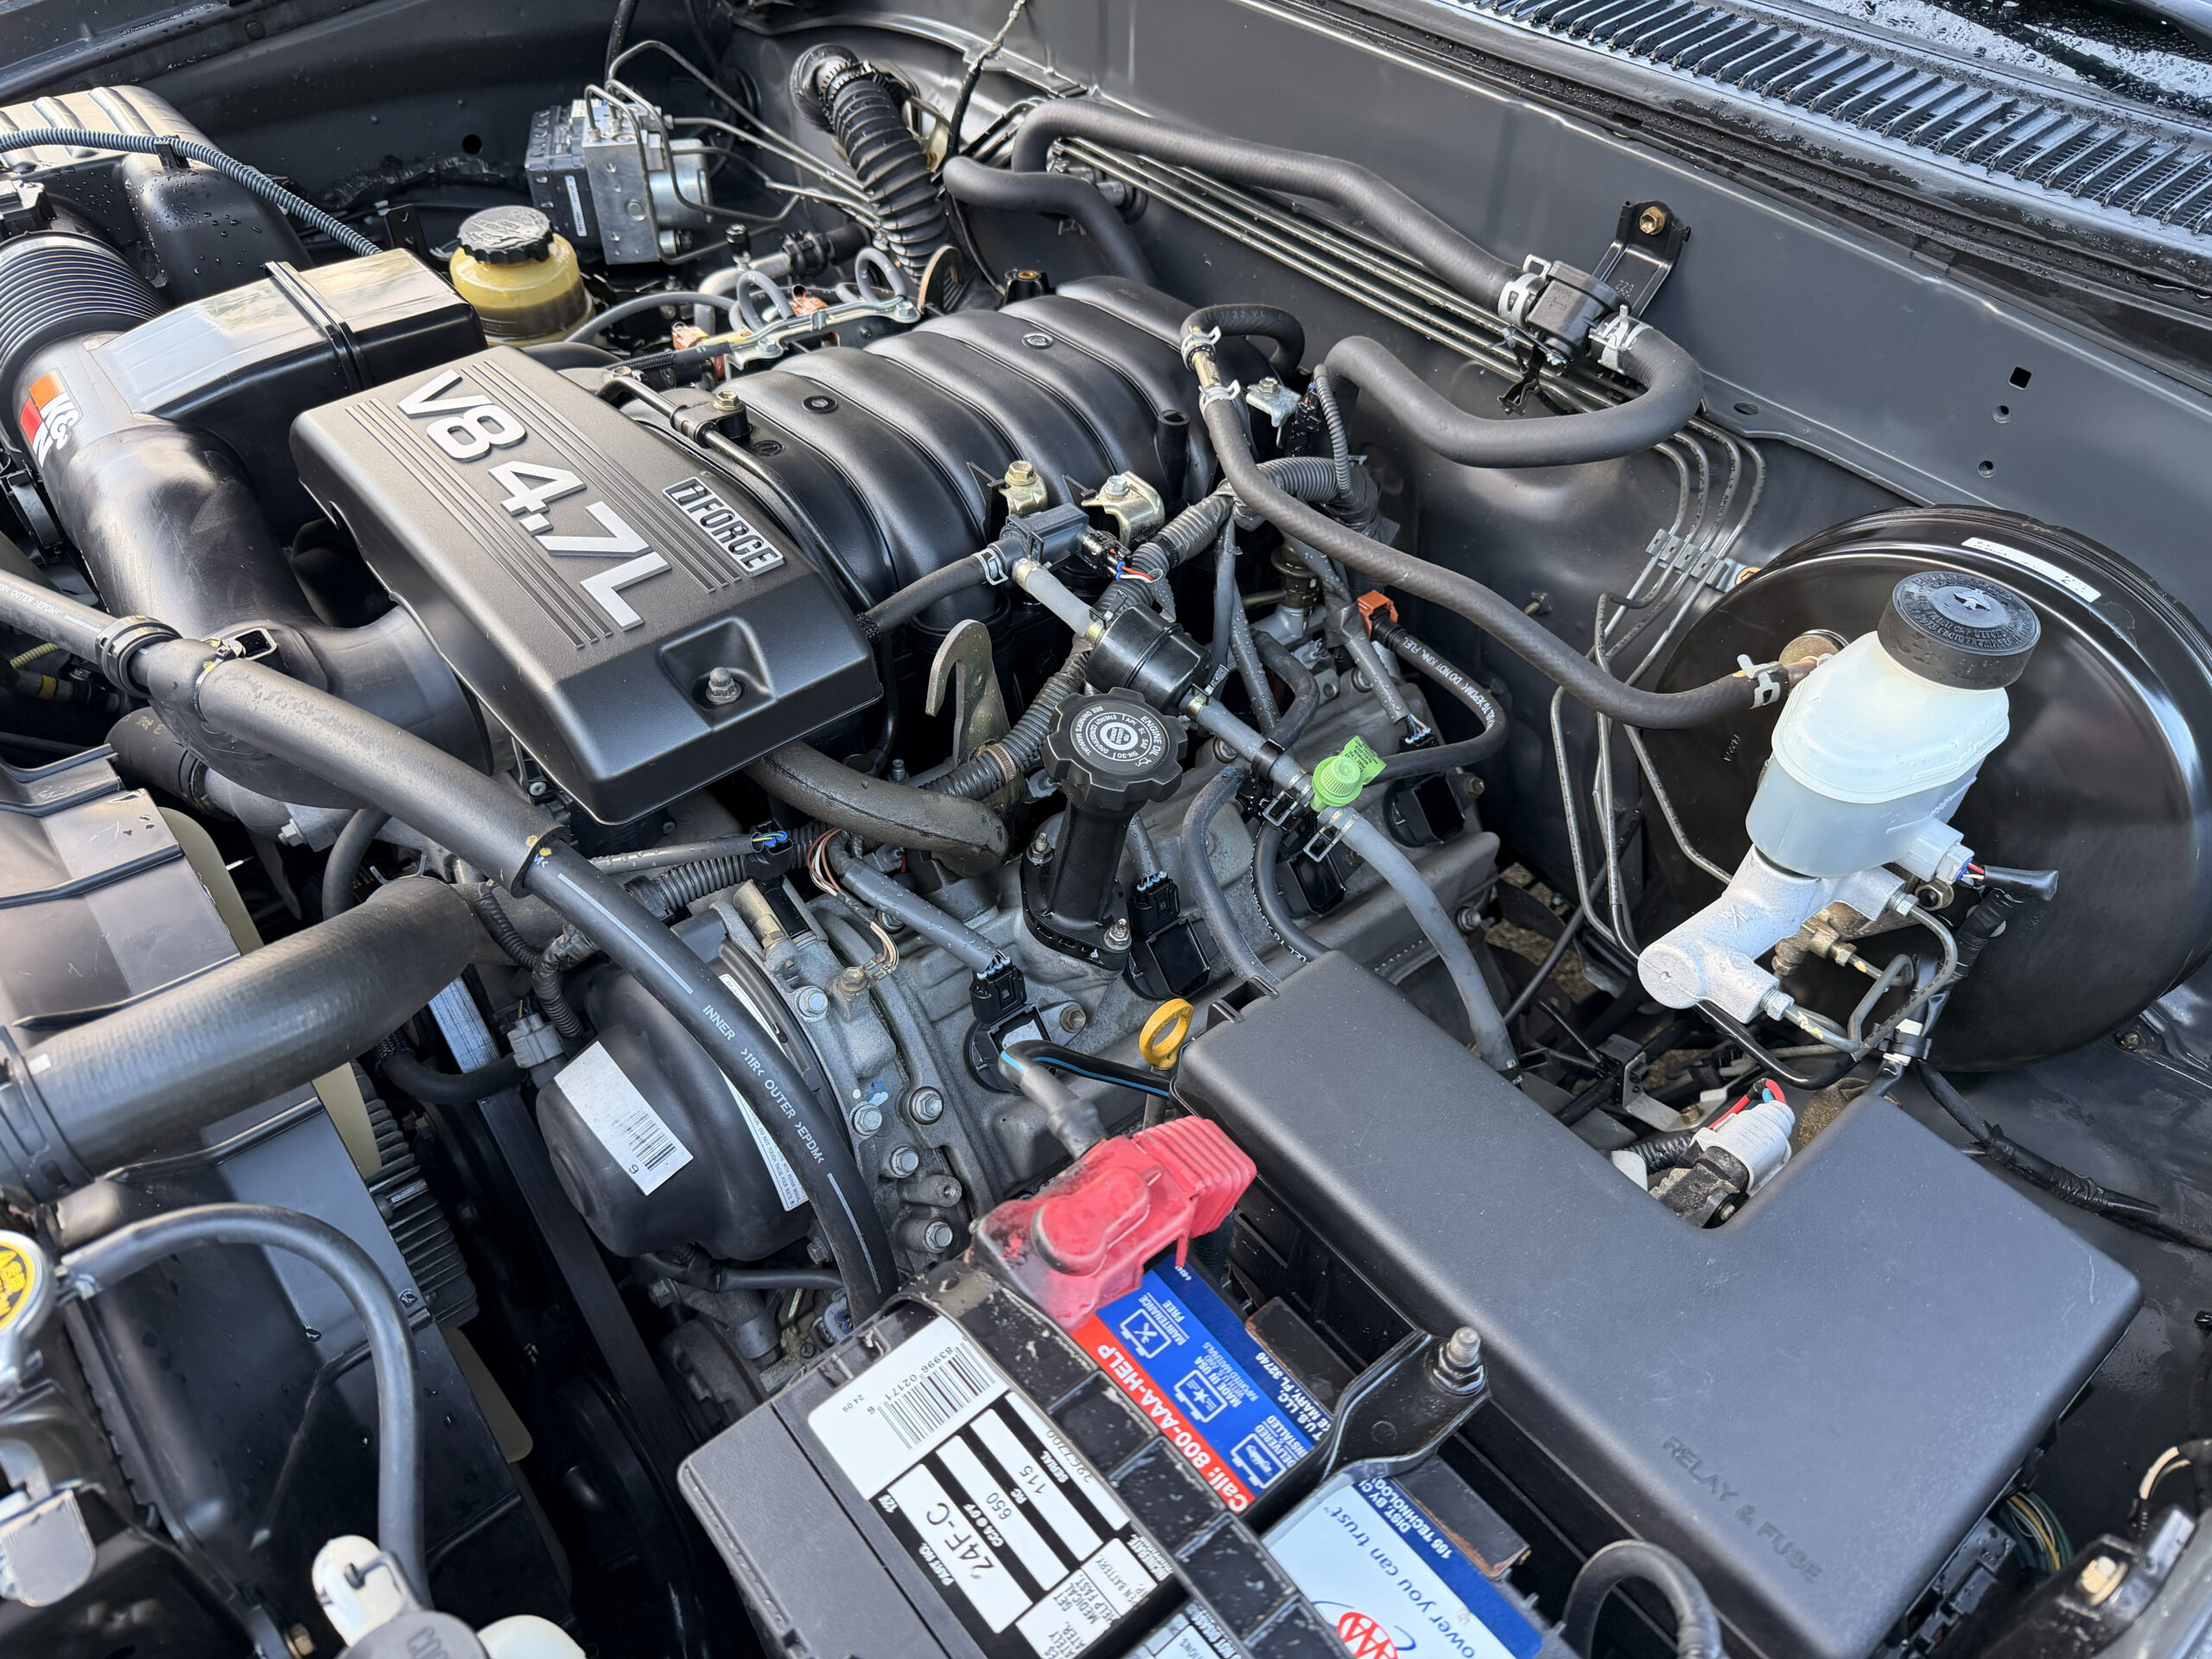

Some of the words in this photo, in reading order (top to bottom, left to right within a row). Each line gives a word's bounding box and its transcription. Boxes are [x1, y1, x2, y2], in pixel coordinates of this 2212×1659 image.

[32, 391, 79, 468] K&N
[397, 368, 527, 462] V8
[487, 460, 672, 632] 4.7L
[10, 588, 34, 604] OUTER
[1402, 637, 1421, 654] FUEL
[1435, 663, 1452, 678] NOT
[1448, 673, 1463, 685] DO
[1076, 734, 1092, 756] MANUAL
[1141, 715, 1162, 746] ENGINE
[1149, 746, 1161, 757] OIL
[702, 1004, 736, 1040] INNER
[765, 1079, 797, 1120] OUTER
[795, 1122, 825, 1164] >EPDM<
[1138, 1294, 1188, 1346] MAINTENANCE
[1161, 1298, 1185, 1323] FREE
[921, 1346, 954, 1374] 83996
[1192, 1354, 1213, 1376] USA
[1203, 1352, 1219, 1370] AND
[1254, 1350, 1283, 1381] 32746
[885, 1374, 918, 1402] 02171
[1207, 1370, 1222, 1385] IN
[1277, 1375, 1294, 1393] FL
[1096, 1343, 1212, 1470] 800-AAA-HELP
[1216, 1380, 1243, 1408] MADE
[1290, 1387, 1322, 1421] MARY,
[867, 1405, 875, 1414] 6
[1254, 1422, 1297, 1468] DELIVERED
[1265, 1413, 1307, 1459] INSTALLED
[1019, 1465, 1048, 1495] 115
[1039, 1450, 1069, 1483] SERIAL
[1010, 1488, 1028, 1504] RC
[1207, 1465, 1248, 1514] Call:
[1368, 1488, 1388, 1509] BY
[986, 1491, 1013, 1521] 650
[1663, 1436, 1738, 1501] RELAY
[1735, 1503, 1756, 1525] &
[1756, 1521, 1822, 1584] FUSE
[926, 1502, 995, 1580] 24F-C
[985, 1524, 1004, 1548] CCA
[932, 1557, 955, 1586] PART
[1370, 1547, 1400, 1577] can
[1052, 1595, 1073, 1612] GET
[1064, 1582, 1103, 1625] MEDICAL
[1397, 1577, 1437, 1612] you
[1091, 1598, 1117, 1624] HELP
[1428, 1614, 1476, 1659] ower
